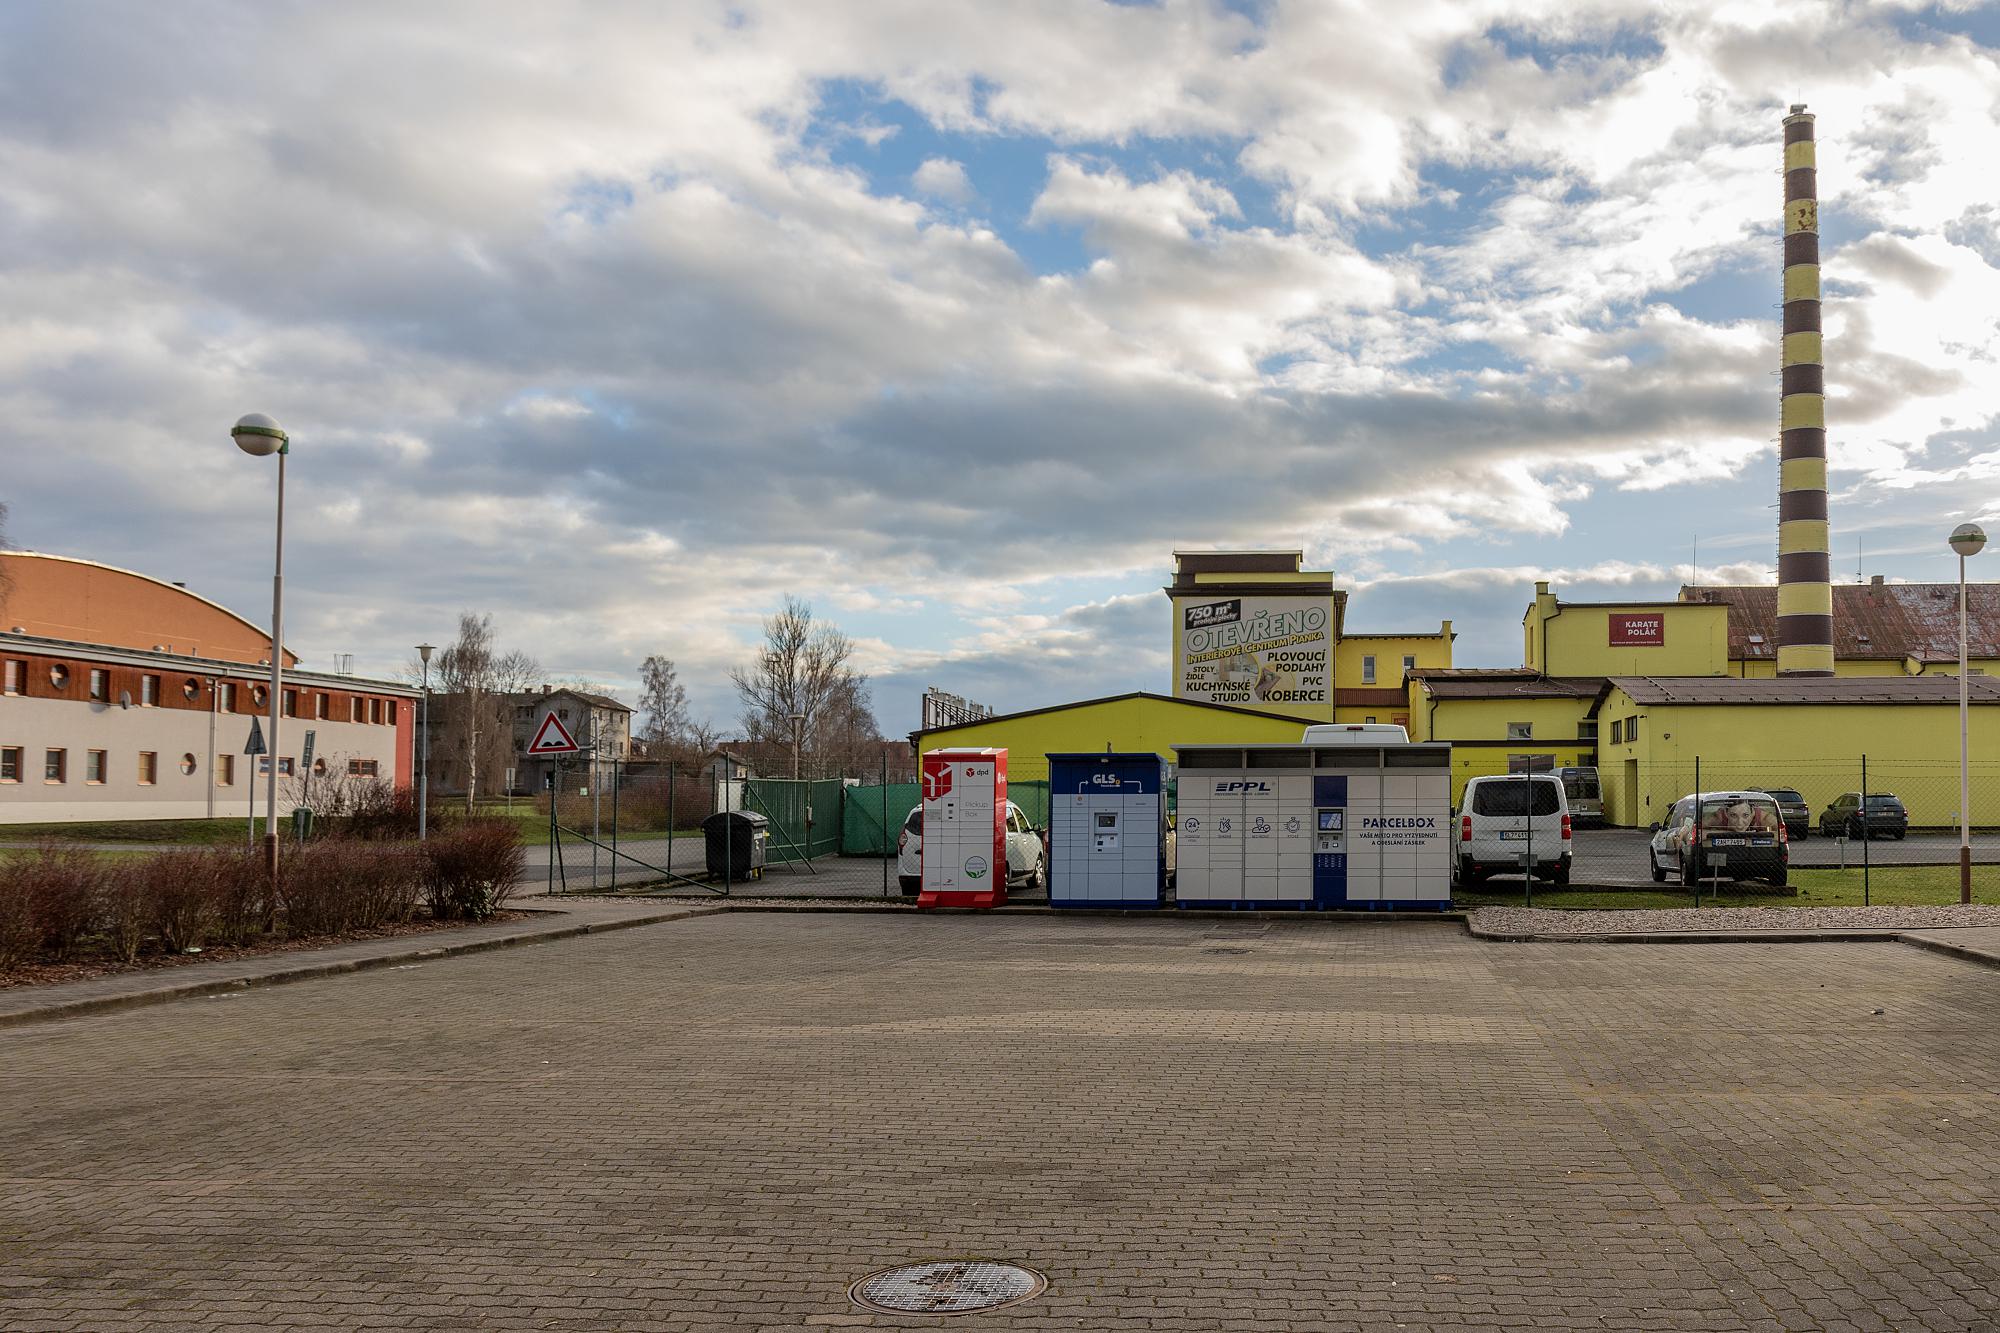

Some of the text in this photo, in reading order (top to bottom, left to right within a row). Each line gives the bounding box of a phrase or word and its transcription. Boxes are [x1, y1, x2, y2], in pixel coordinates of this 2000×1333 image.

[1188, 606, 1212, 621] 750
[1186, 606, 1326, 653] OTEVŘENO
[1627, 627, 1656, 636] POLÁK
[1267, 649, 1327, 662] PLOVOUCÍ
[1275, 663, 1326, 673] PODLAHY
[1186, 672, 1205, 680] ŽIDLE
[1186, 679, 1251, 692] KUCHYŇSKÉ
[1302, 677, 1323, 686] PVC
[1210, 692, 1251, 702] STUDIO
[1262, 690, 1325, 702] KOBERCE
[976, 768, 989, 777] dpd
[1092, 774, 1116, 784] GLS
[1228, 782, 1271, 792] PPL
[1363, 817, 1435, 828] PARCELBOX
